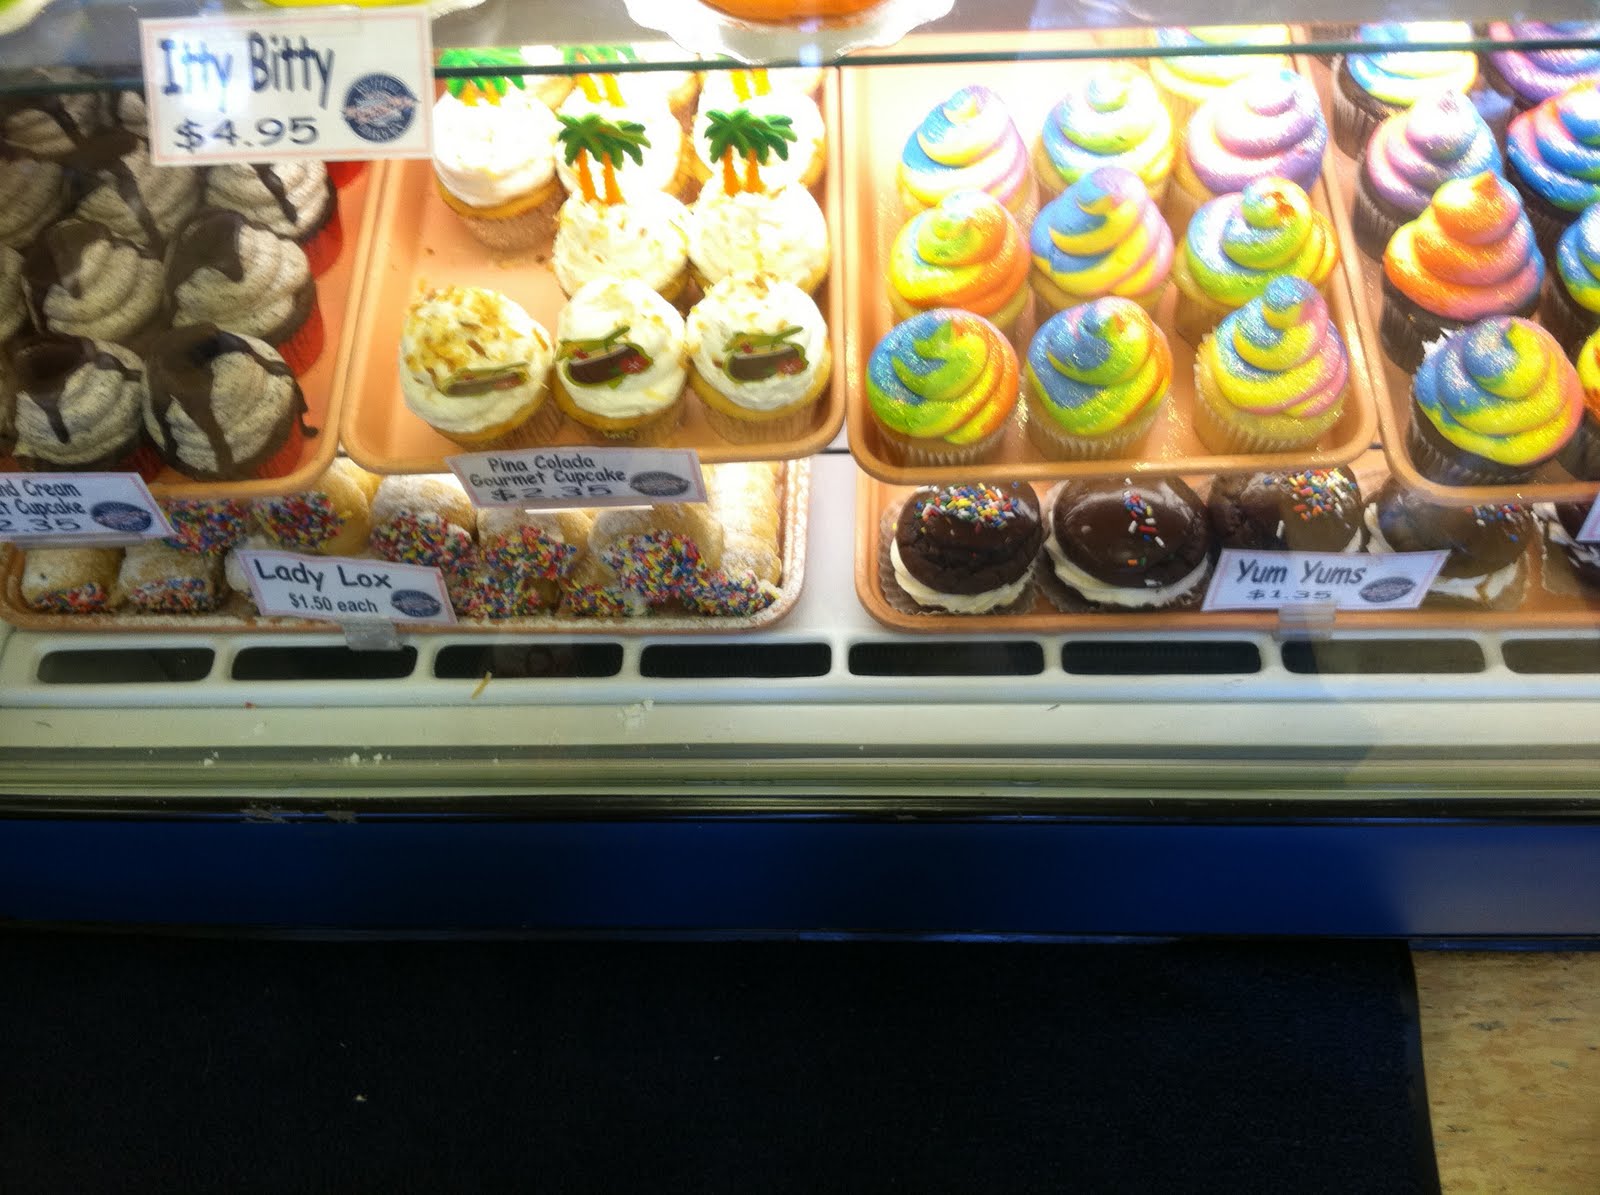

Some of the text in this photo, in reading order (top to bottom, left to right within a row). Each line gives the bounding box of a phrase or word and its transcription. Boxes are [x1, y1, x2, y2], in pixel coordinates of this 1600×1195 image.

[158, 37, 233, 113] Itty
[248, 30, 335, 110] Bitty
[174, 117, 318, 151] $4.95
[488, 453, 596, 473] Pina Colada
[22, 478, 82, 497] Cream
[469, 470, 544, 488] Gourmet
[553, 467, 626, 484] Cupcake
[489, 485, 613, 502] $2.35
[14, 498, 87, 519] Cupcake
[254, 559, 392, 592] Lady Lox
[1236, 559, 1367, 585] Yum Yums
[288, 593, 333, 611] $1.50
[337, 598, 379, 613] each
[1246, 589, 1332, 601] $1.35
